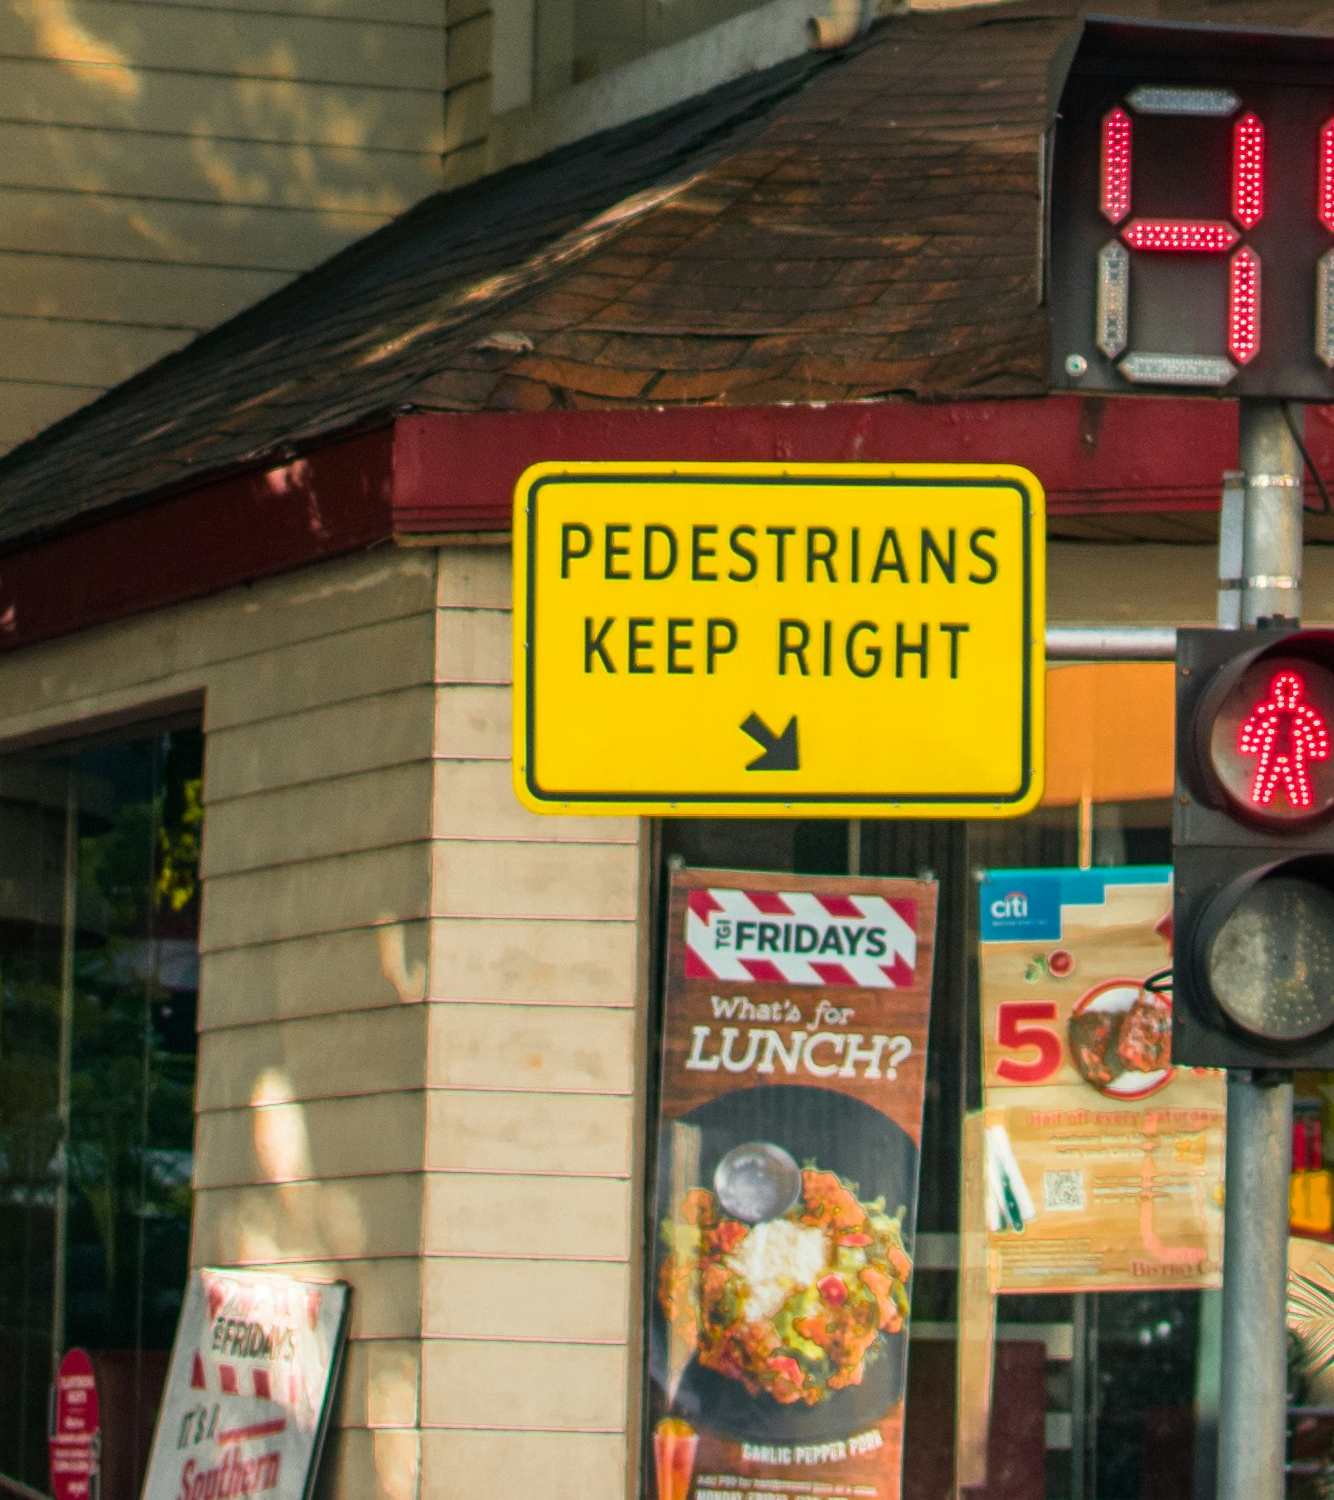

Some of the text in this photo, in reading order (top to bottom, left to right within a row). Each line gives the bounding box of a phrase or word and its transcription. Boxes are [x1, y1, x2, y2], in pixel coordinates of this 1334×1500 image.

[559, 521, 1001, 586] PEDESTRIANS
[583, 616, 971, 681] KEEP RIGHT
[990, 894, 1028, 918] citi
[715, 919, 888, 958] TGI FRIDAYS
[710, 995, 855, 1032] What's for
[685, 1025, 914, 1082] LUNCH?
[794, 1440, 847, 1465] PEPPER
